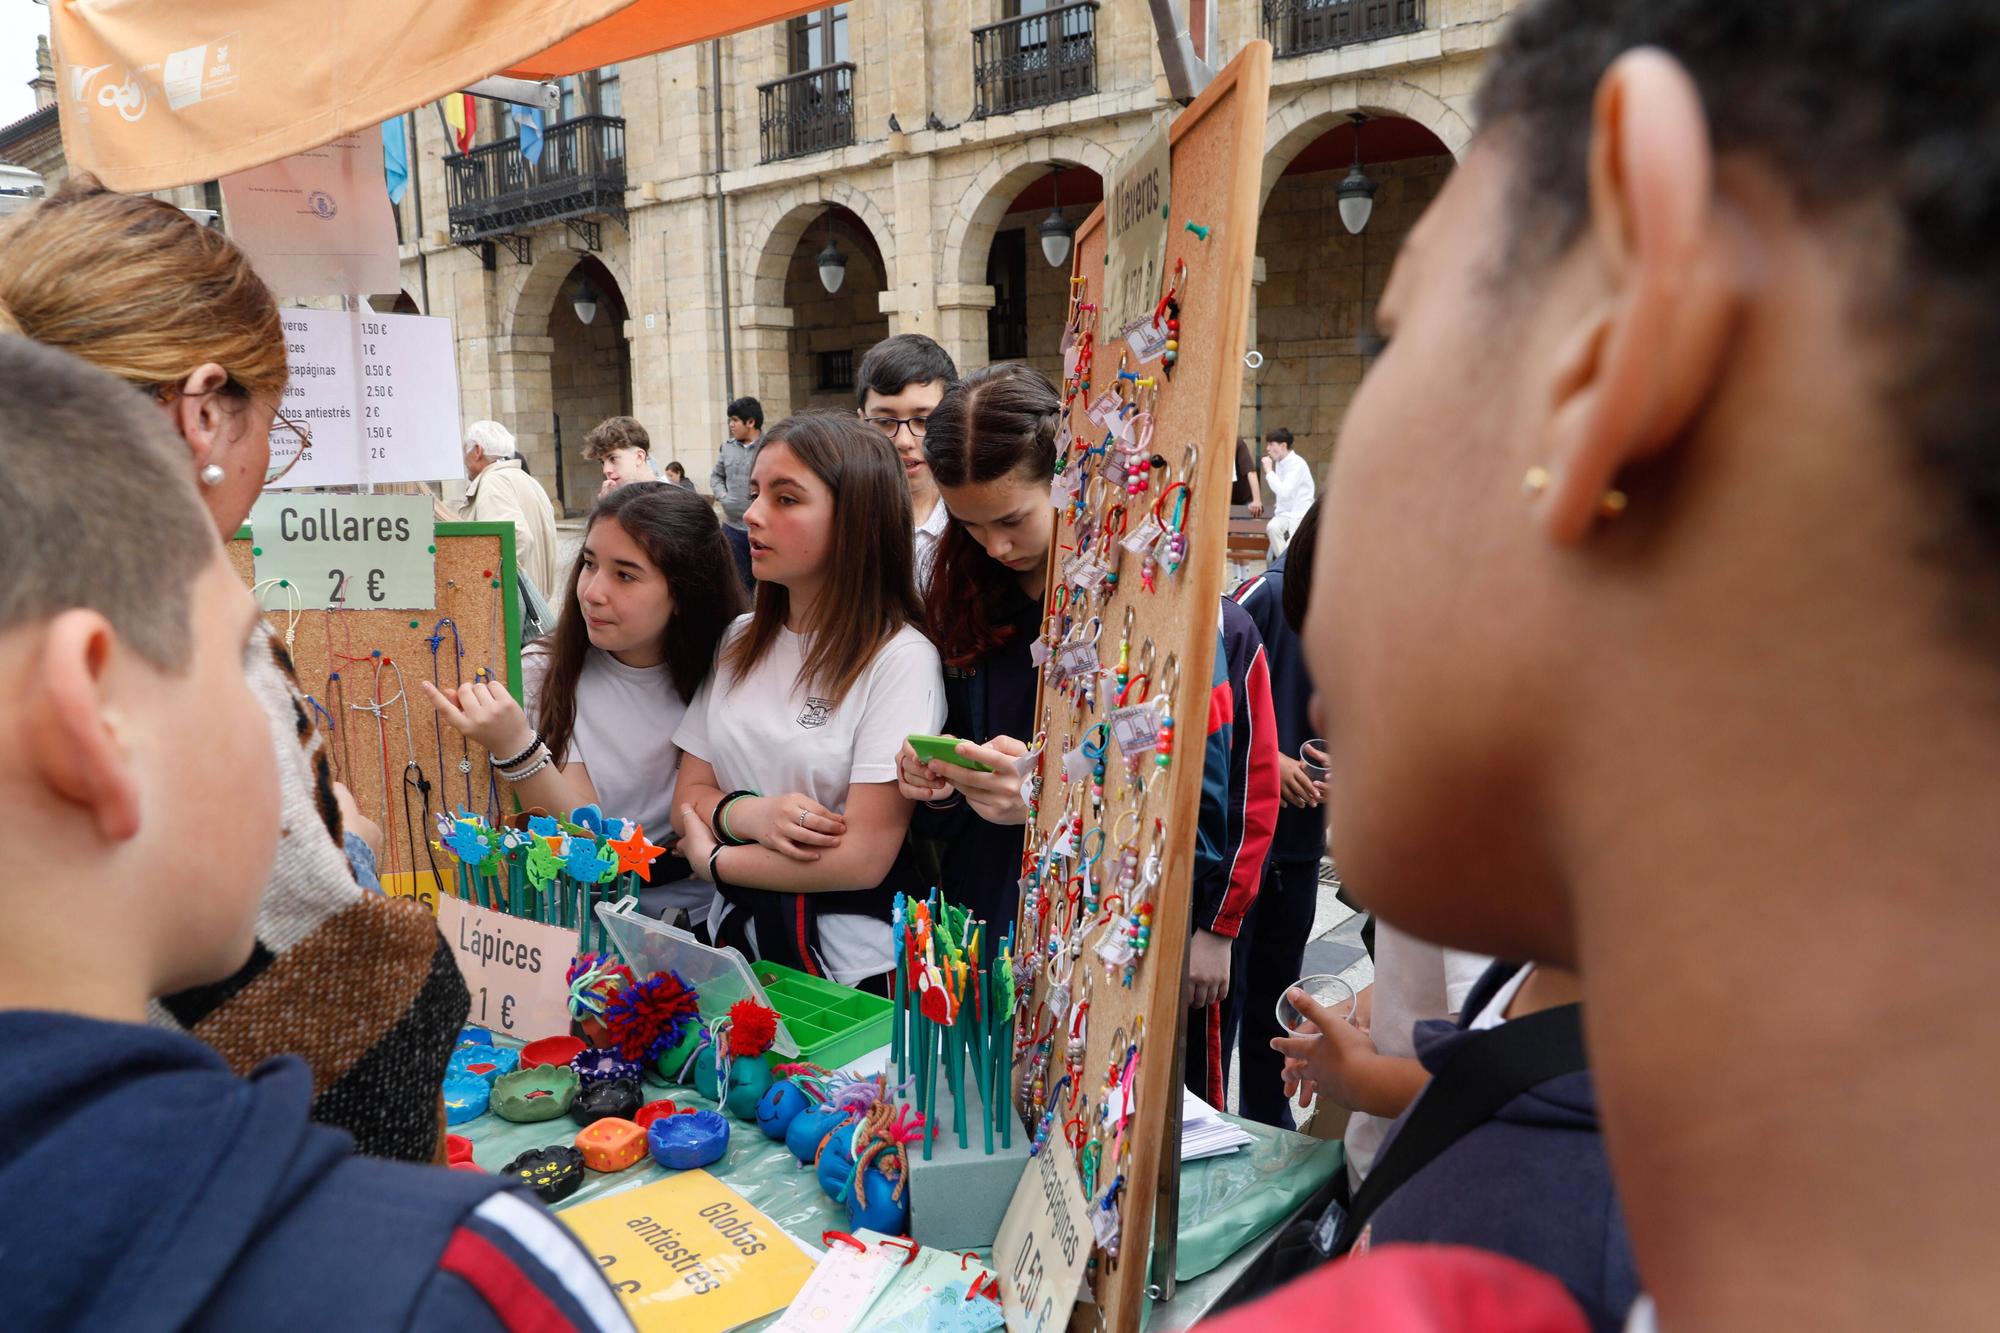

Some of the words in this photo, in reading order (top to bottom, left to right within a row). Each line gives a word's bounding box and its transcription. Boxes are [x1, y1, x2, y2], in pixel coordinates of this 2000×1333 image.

[1115, 167, 1159, 237] Llaveros
[282, 320, 308, 331] veros
[362, 323, 379, 335] 1.50
[381, 324, 388, 335] €
[286, 341, 306, 353] ices
[363, 344, 368, 355] 1
[370, 344, 376, 356] €
[289, 362, 336, 378] capáginas
[365, 364, 384, 376] 0.50
[386, 365, 392, 376] €
[284, 387, 305, 397] eros
[367, 385, 385, 397] 2.50
[387, 386, 394, 397] €
[279, 406, 302, 418] obos
[304, 405, 351, 418] antiestrés
[365, 406, 372, 418] 2
[374, 407, 380, 418] €
[366, 426, 384, 438] 1.50
[386, 427, 393, 438] €
[371, 447, 378, 459] 2
[379, 448, 386, 459] €
[280, 507, 410, 542] Collares
[328, 569, 346, 603] 2
[366, 569, 386, 602] €
[459, 916, 542, 973] Lápices
[479, 987, 488, 1021] 1
[500, 994, 516, 1030] €
[698, 1201, 767, 1256] Globos
[626, 1216, 721, 1295] antiestrés
